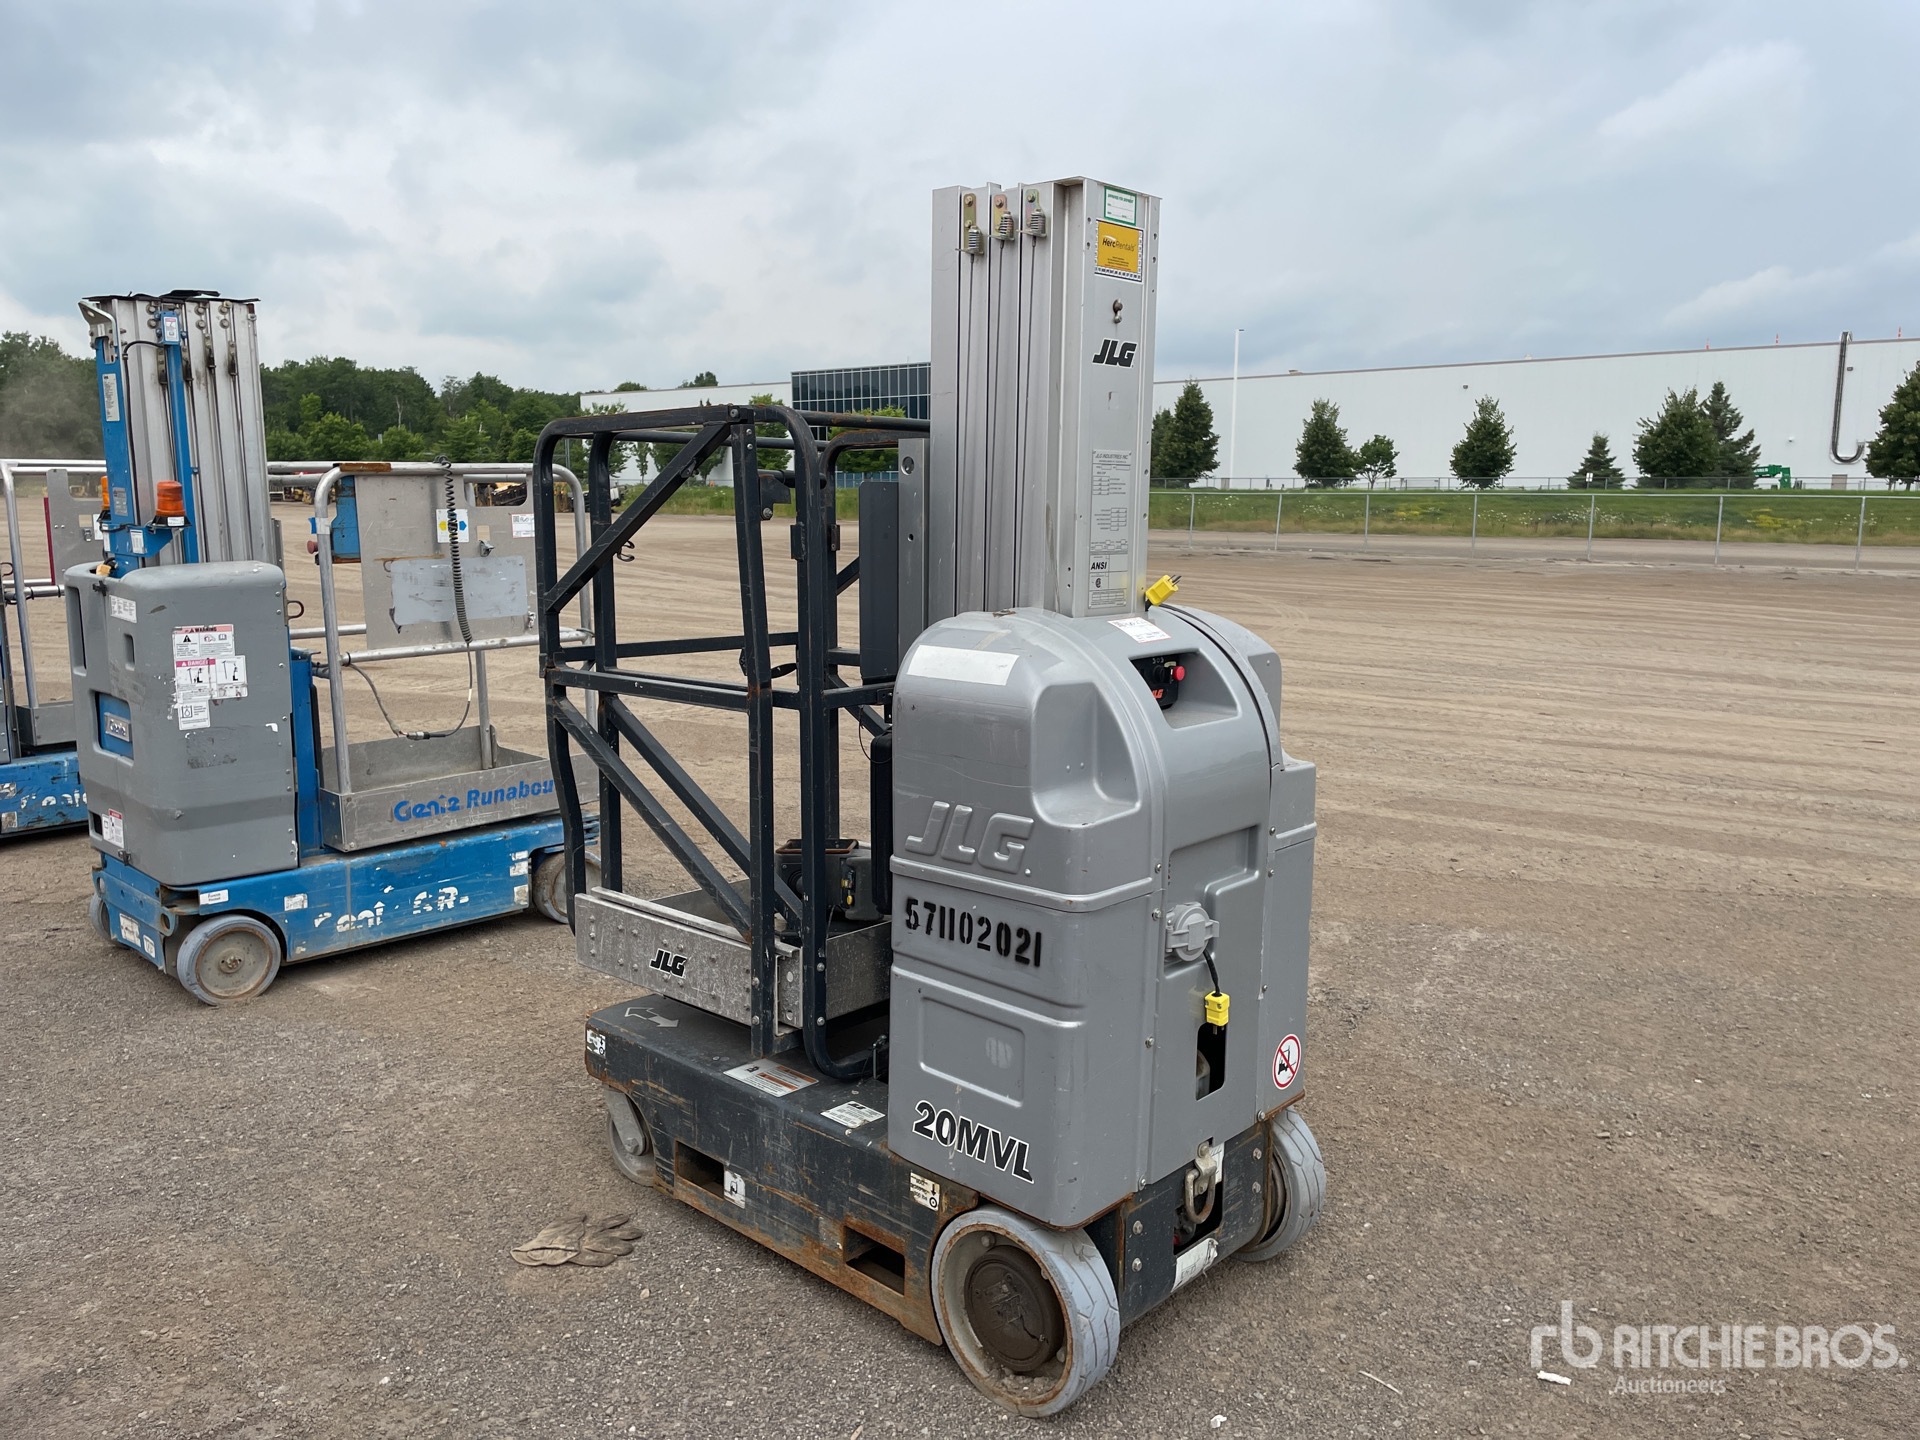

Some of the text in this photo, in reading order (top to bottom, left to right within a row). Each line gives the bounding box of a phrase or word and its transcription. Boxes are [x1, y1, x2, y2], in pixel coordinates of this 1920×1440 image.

[1092, 338, 1137, 368] JLG
[1090, 561, 1107, 570] ANSI
[466, 780, 554, 809] Runabou
[904, 897, 1042, 967] 571102021
[649, 948, 688, 978] JLG
[912, 1100, 1034, 1184] 20MVL
